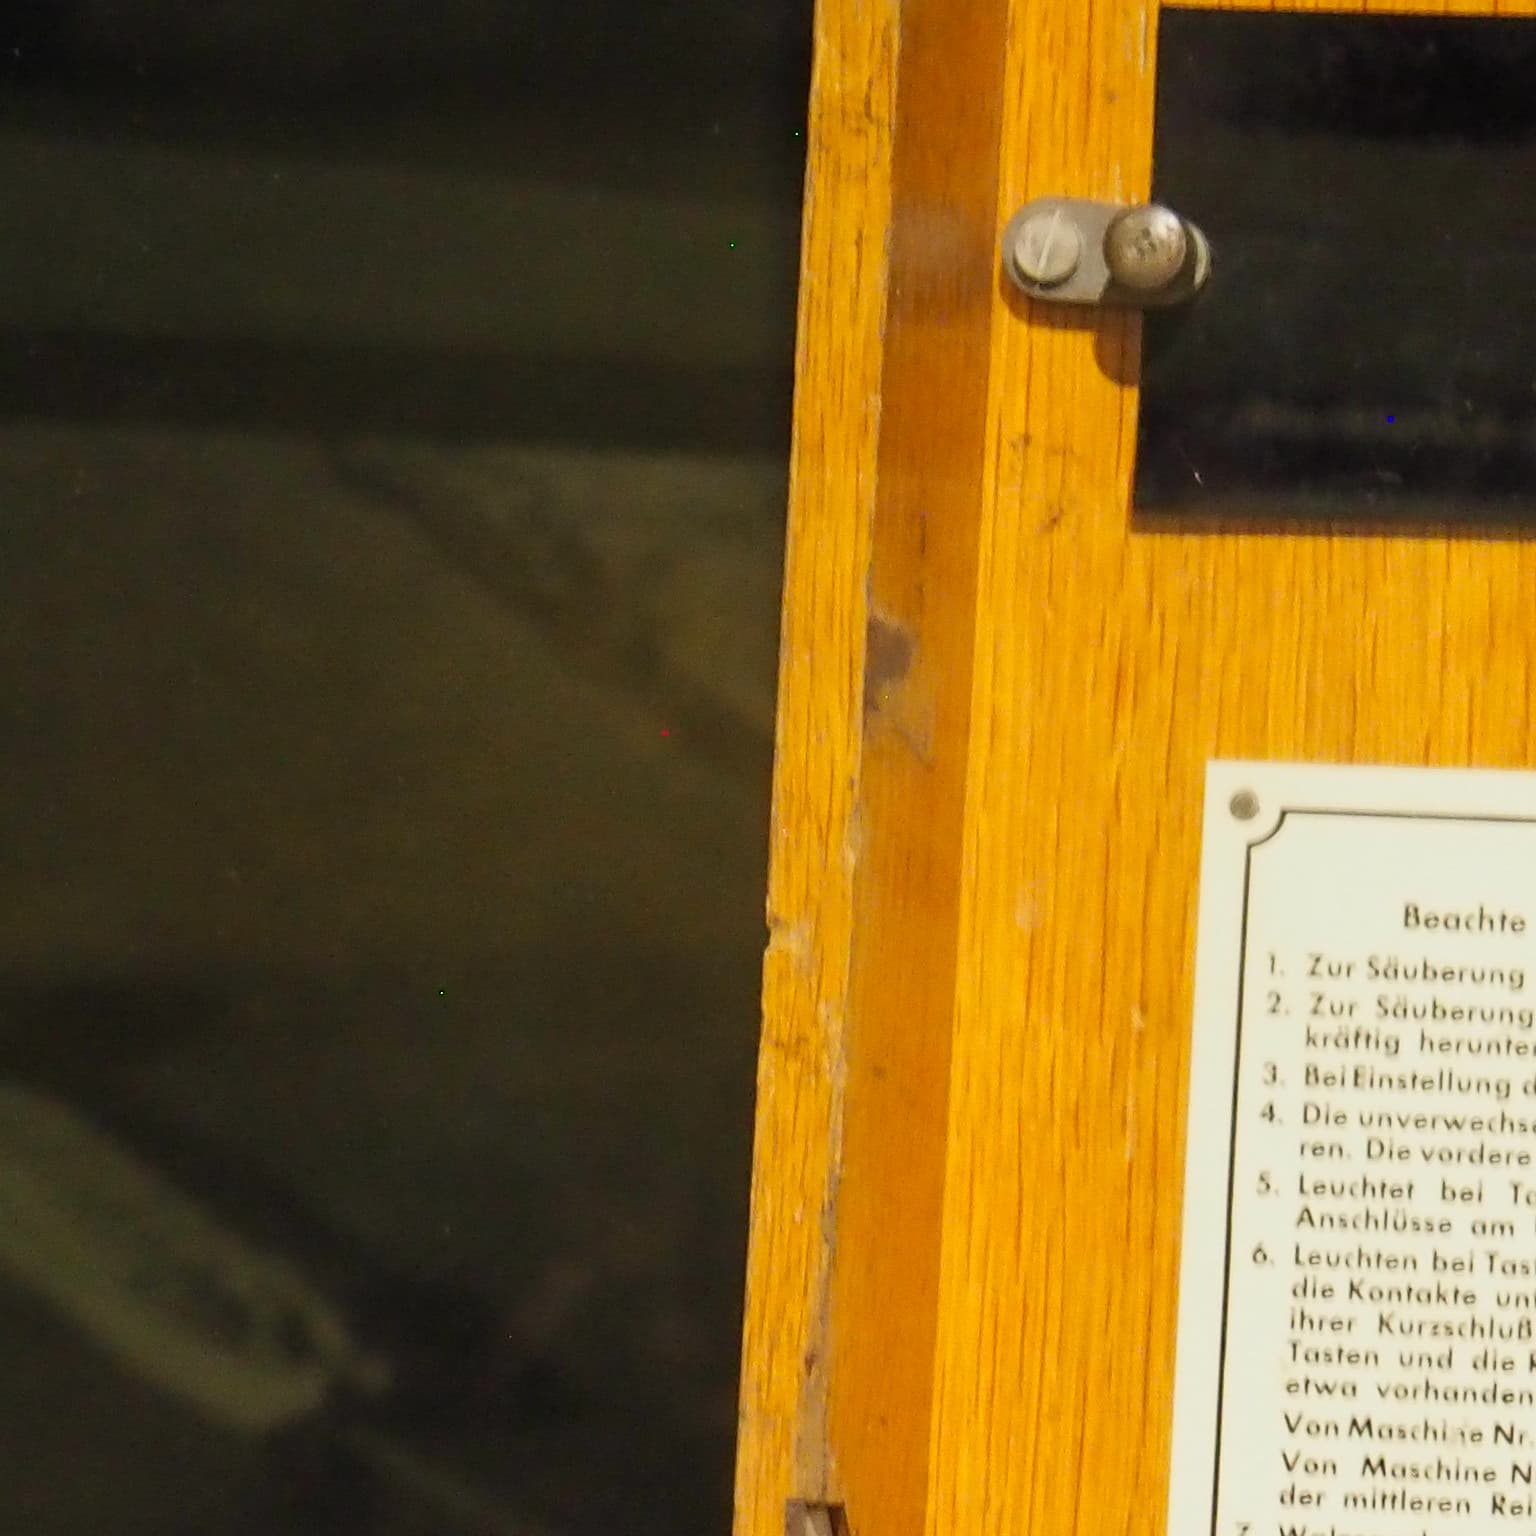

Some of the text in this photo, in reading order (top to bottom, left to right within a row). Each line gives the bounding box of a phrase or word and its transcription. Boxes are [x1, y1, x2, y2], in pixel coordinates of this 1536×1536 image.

[1401, 901, 1527, 935] Beachte
[1267, 950, 1285, 976] 1.
[1305, 951, 1356, 980] Zur
[1365, 953, 1526, 993] Säuberung
[1265, 988, 1290, 1016] 2.
[1308, 990, 1358, 1019] Zur
[1374, 992, 1535, 1032] Säuberung
[1303, 1022, 1401, 1059] kräftig
[1261, 1060, 1284, 1087] 3.
[1302, 1061, 1347, 1089] Bei
[1350, 1062, 1512, 1103] Einstellung
[1255, 1169, 1279, 1196] 5.
[1296, 1170, 1415, 1202] Leuchtet
[1438, 1175, 1484, 1205] bei
[1293, 1202, 1453, 1235] Anschlüsse
[1468, 1218, 1516, 1239] am
[1279, 1447, 1338, 1477] Von
[1359, 1452, 1498, 1485] Maschine
